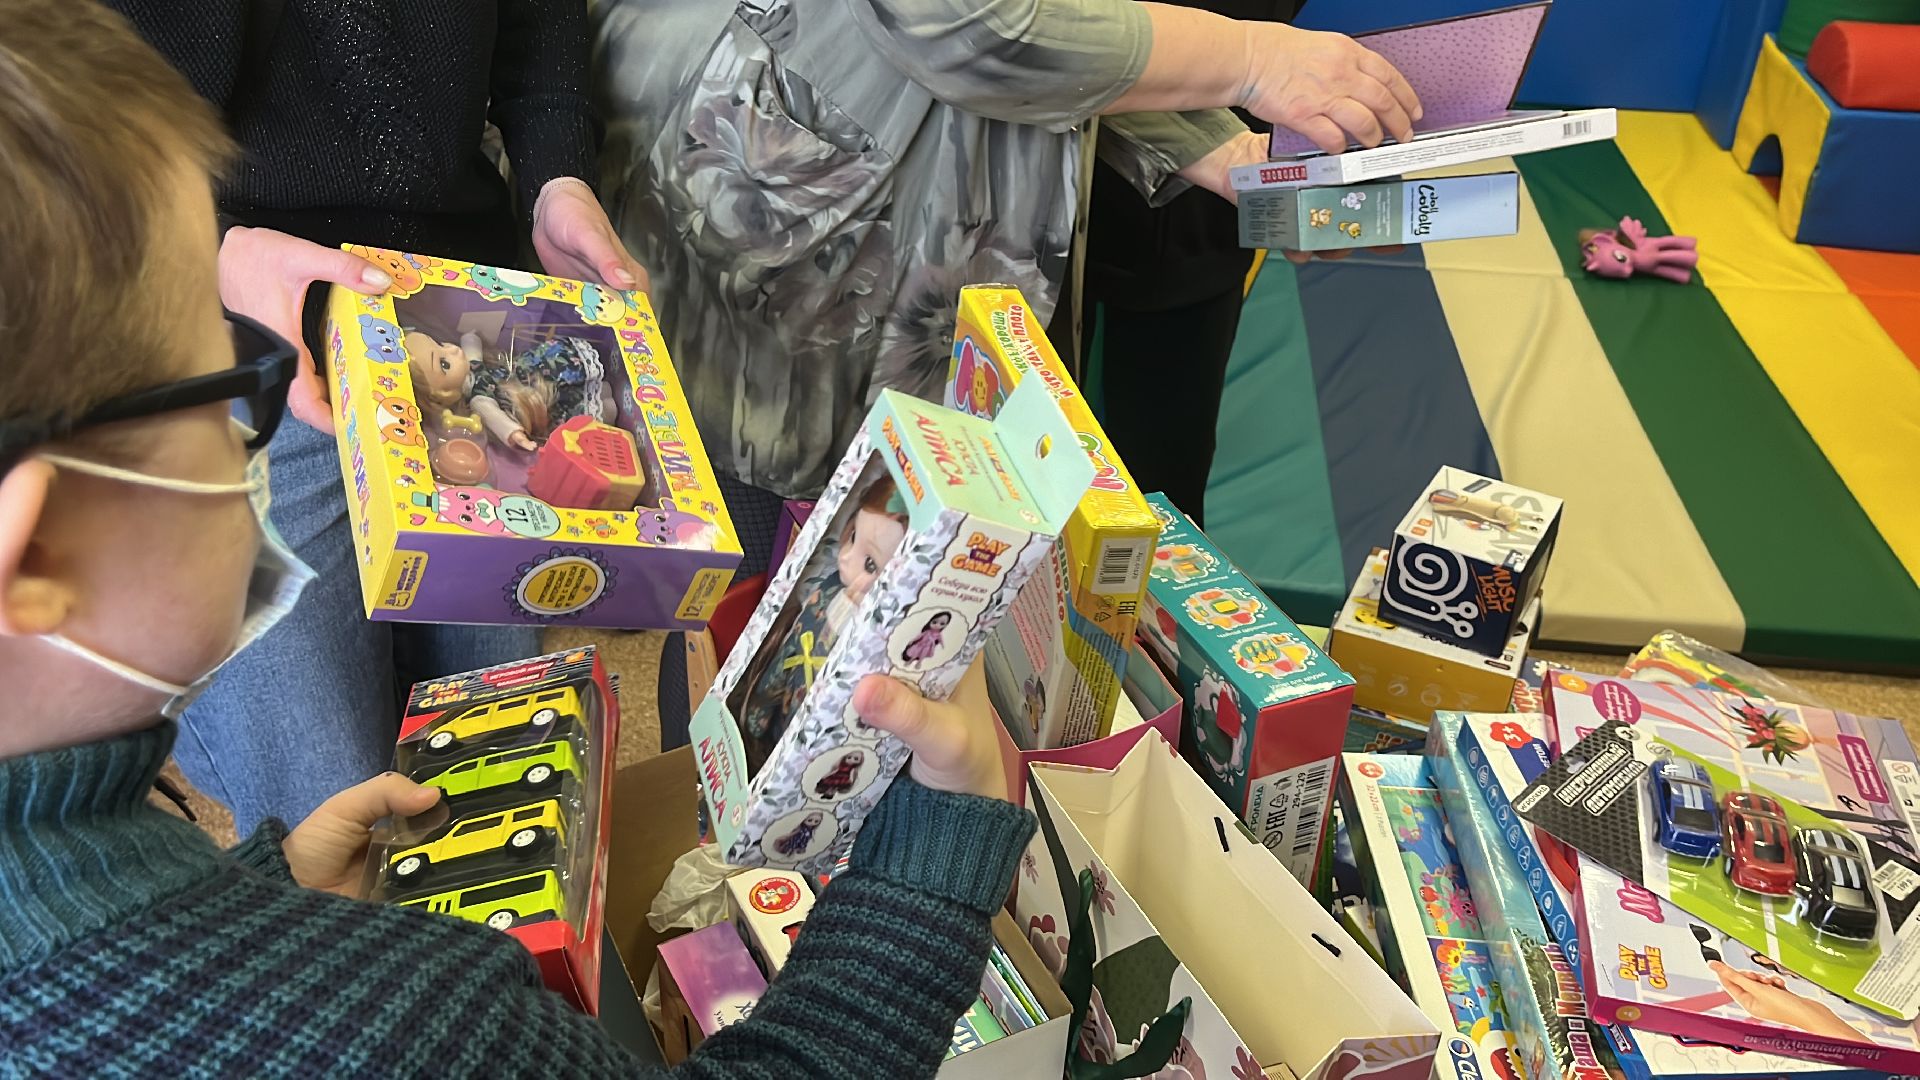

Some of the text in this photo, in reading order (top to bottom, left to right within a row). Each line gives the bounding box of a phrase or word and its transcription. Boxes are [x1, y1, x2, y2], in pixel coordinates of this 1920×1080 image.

[1010, 304, 1026, 337] ПЛОХО
[619, 328, 702, 492] МИЛЫЕ ДРУЗЬЯ
[911, 410, 967, 486] АЛИСА
[505, 508, 529, 523] 12
[966, 531, 1012, 556] PLAY
[951, 554, 1002, 577] GAME
[418, 692, 470, 709] GAME
[427, 678, 470, 695] PLAY
[1502, 725, 1522, 743] 3+
[698, 736, 728, 825] АЛИСА
[1291, 772, 1307, 809] 294-129
[1250, 786, 1265, 833] ГРОЛЕНД
[1618, 944, 1640, 981] PLAY
[1645, 945, 1668, 989] GAME
